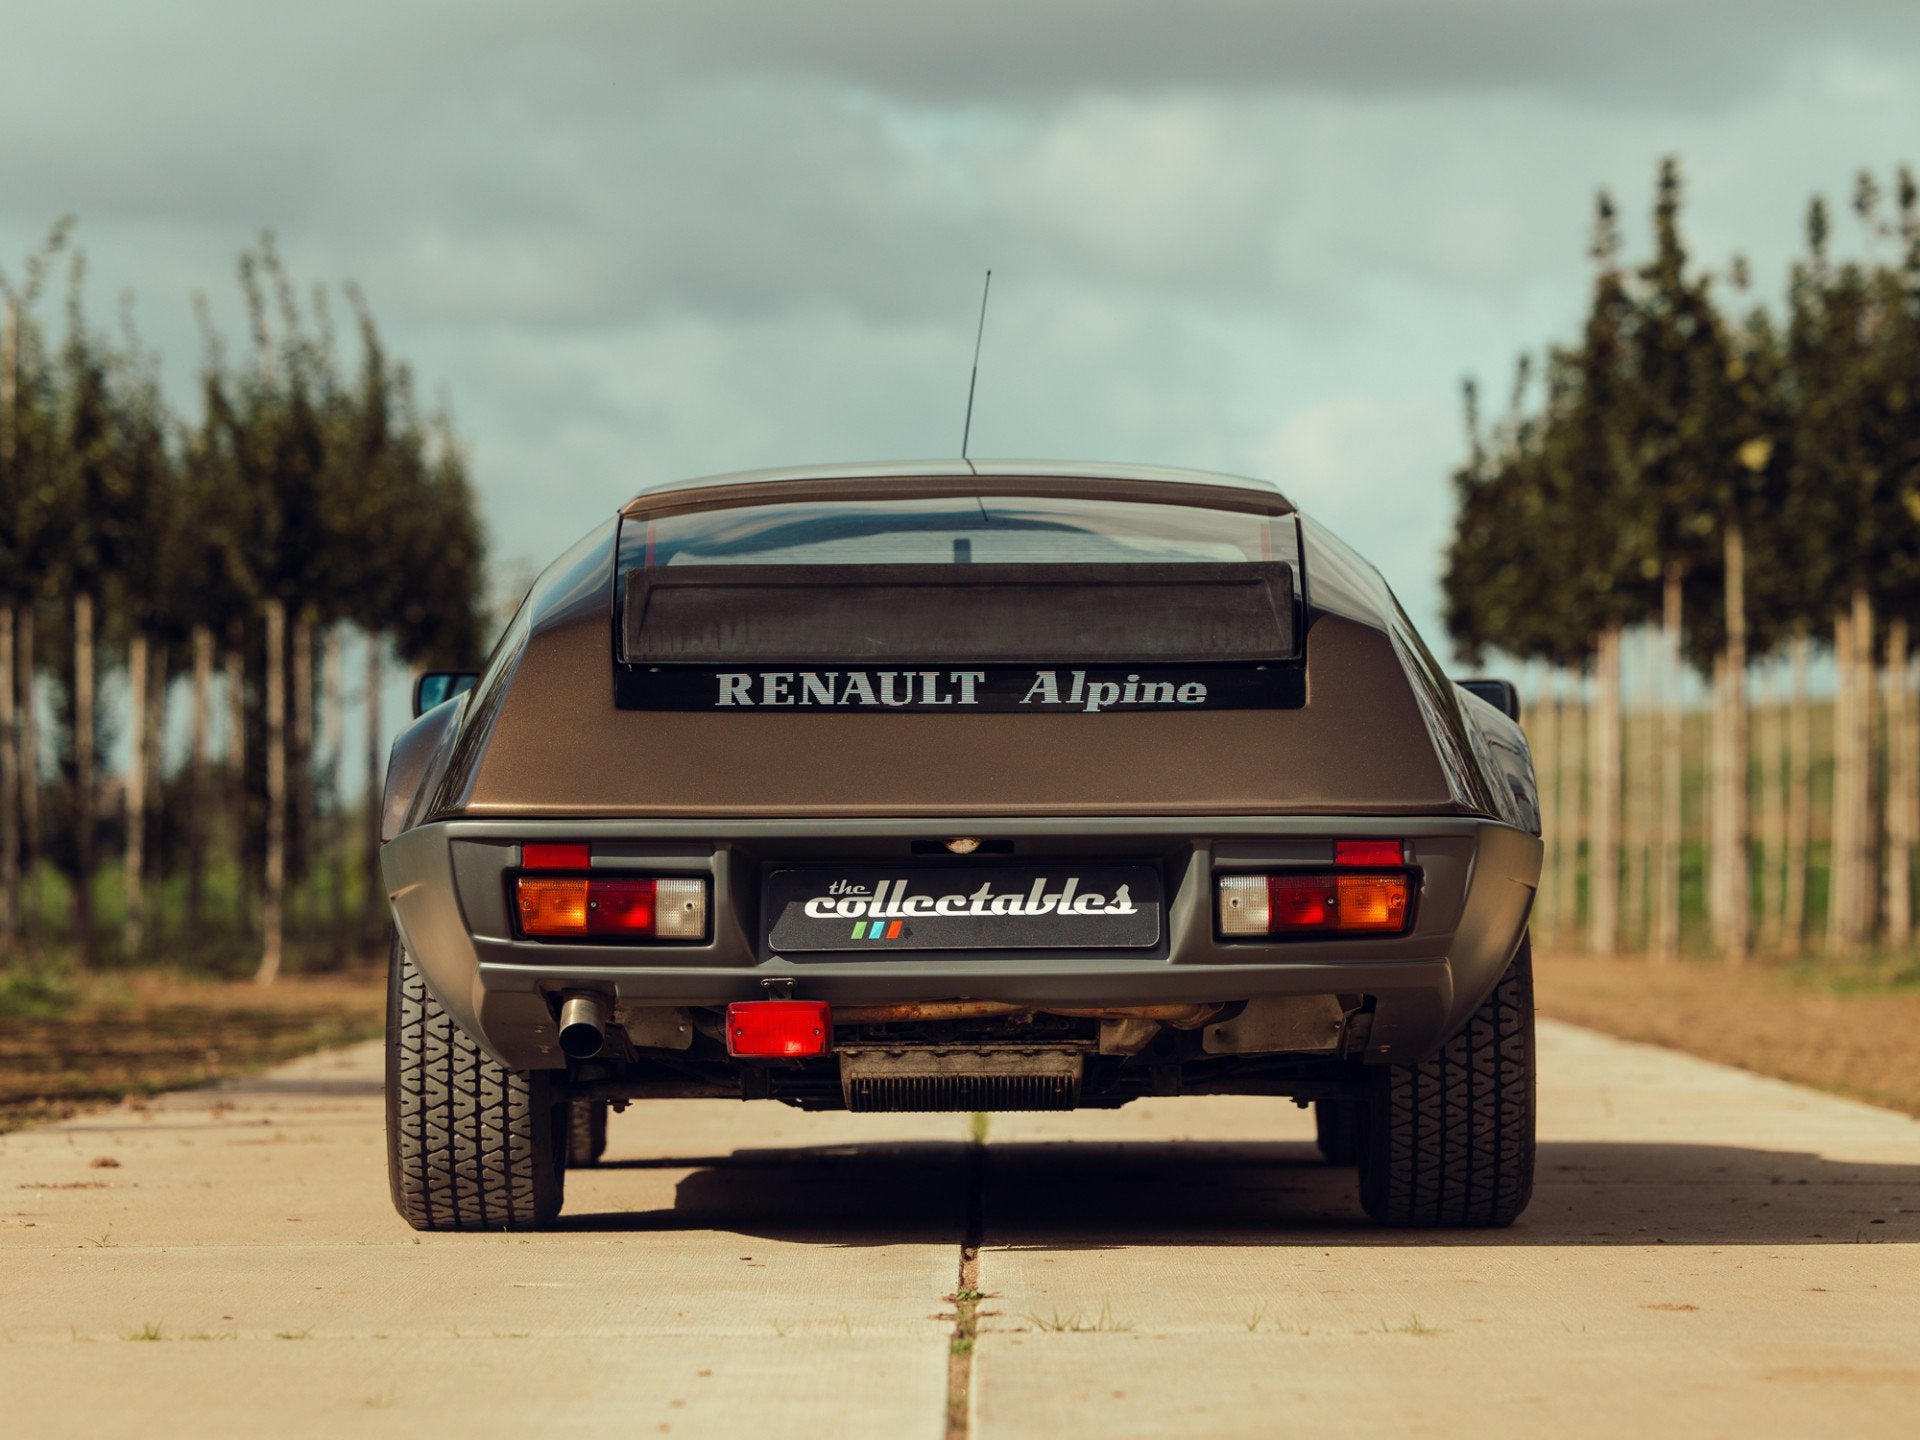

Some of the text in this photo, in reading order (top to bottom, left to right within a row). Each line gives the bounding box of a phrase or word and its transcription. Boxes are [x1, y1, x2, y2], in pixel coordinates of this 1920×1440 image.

[715, 670, 1208, 711] RENAULT Alpine
[804, 877, 1138, 918] collectables
[828, 879, 871, 895] the
